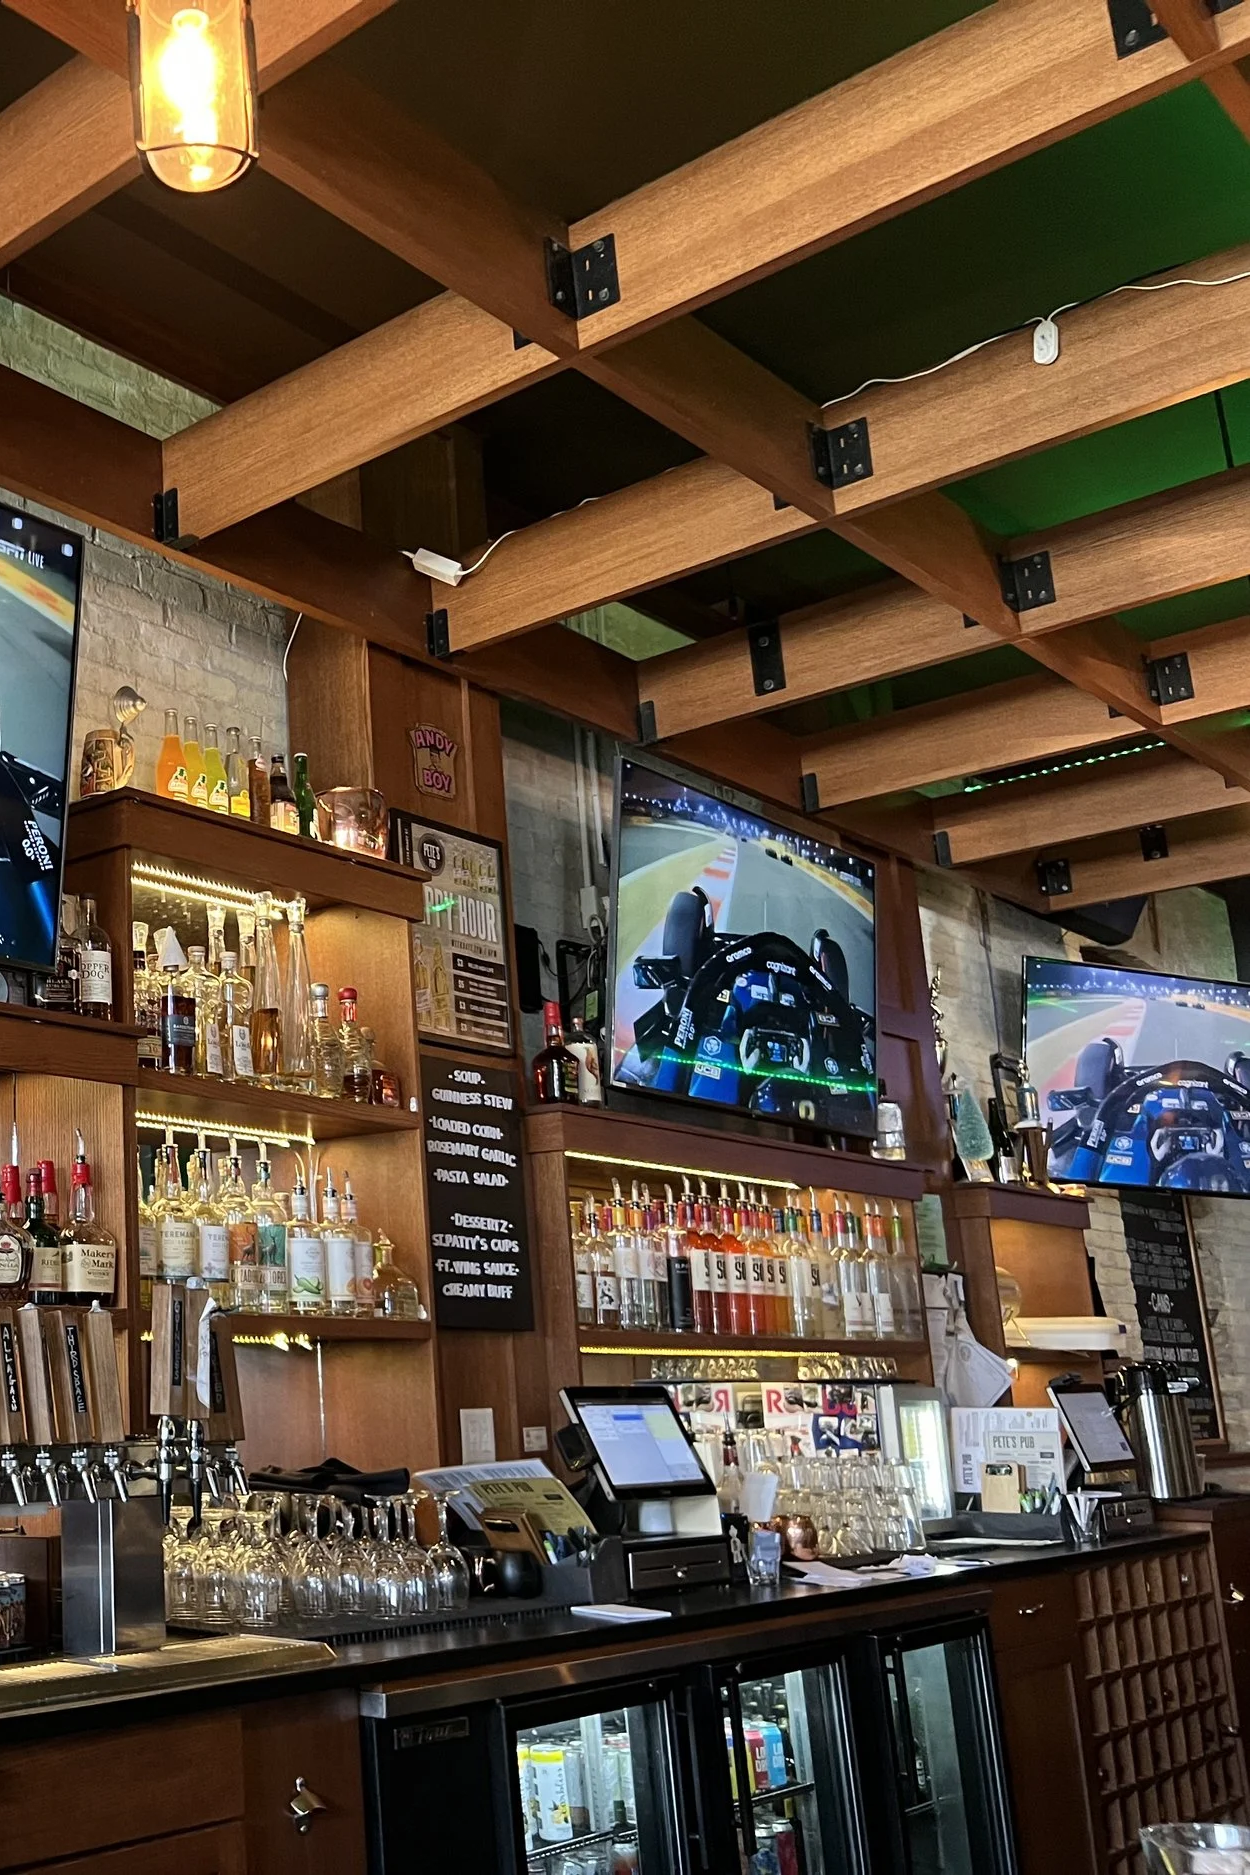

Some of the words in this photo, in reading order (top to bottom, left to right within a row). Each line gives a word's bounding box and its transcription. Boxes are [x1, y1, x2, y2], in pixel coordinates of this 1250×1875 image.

[27, 550, 45, 570] LIVE
[414, 728, 454, 756] ANDY
[422, 769, 452, 793] BOY
[27, 819, 54, 871] PERONI
[422, 885, 455, 931] PPY
[458, 894, 498, 943] HOUR
[82, 969, 105, 980] DOG
[431, 1087, 482, 1105] GUINNESS
[483, 1093, 513, 1111] STEW
[426, 1139, 480, 1158] ROSEMARY
[481, 1147, 517, 1168] GARLIC
[490, 1238, 520, 1253] CUPS
[91, 1259, 114, 1269] Mark
[442, 1282, 486, 1298] CREAMY
[173, 1300, 182, 1380] GUINNESS
[2, 1326, 18, 1412] ALLAGASH
[992, 1435, 1017, 1449] PETE'S
[1020, 1435, 1035, 1449] PUB
